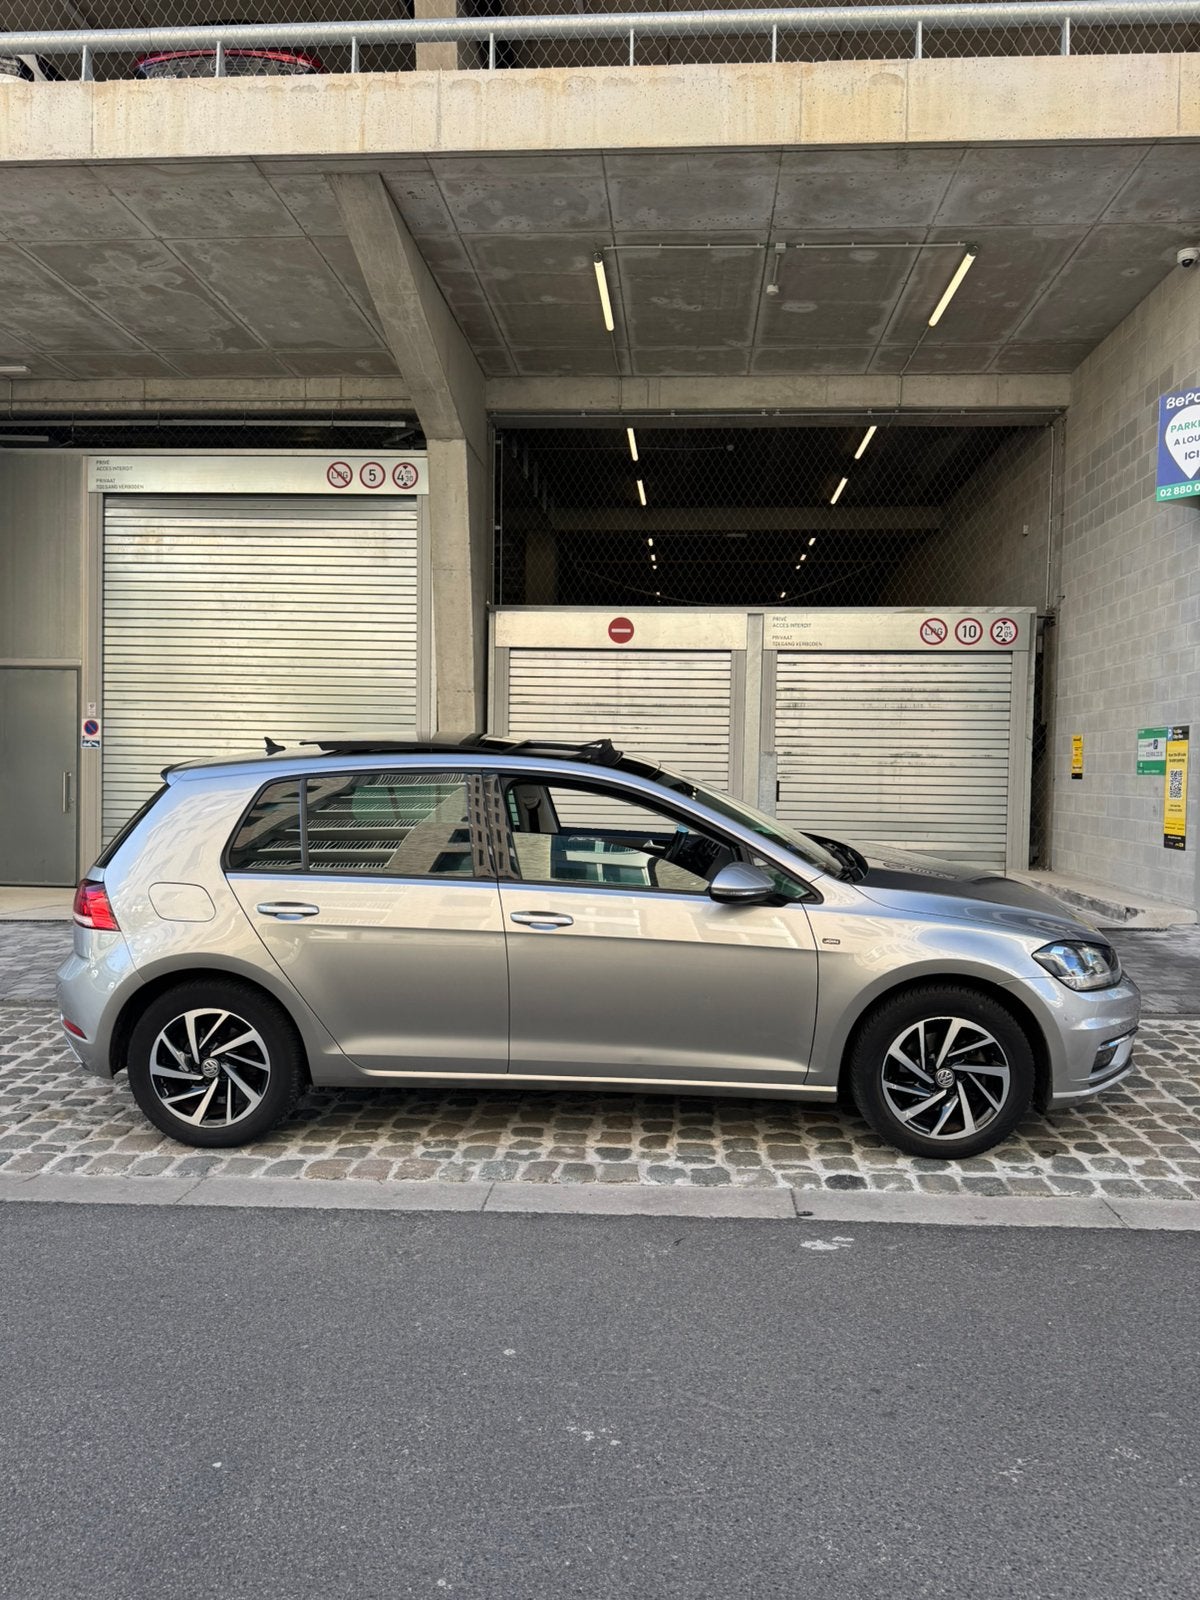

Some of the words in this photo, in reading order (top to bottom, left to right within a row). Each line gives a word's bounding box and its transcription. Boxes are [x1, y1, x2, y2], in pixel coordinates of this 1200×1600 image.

[1184, 450, 1200, 460] ICI
[368, 469, 376, 482] 5
[396, 470, 404, 482] 4
[1160, 488, 1172, 497] 02
[1173, 485, 1192, 495] 880
[962, 625, 977, 638] 10
[995, 625, 1003, 638] 2
